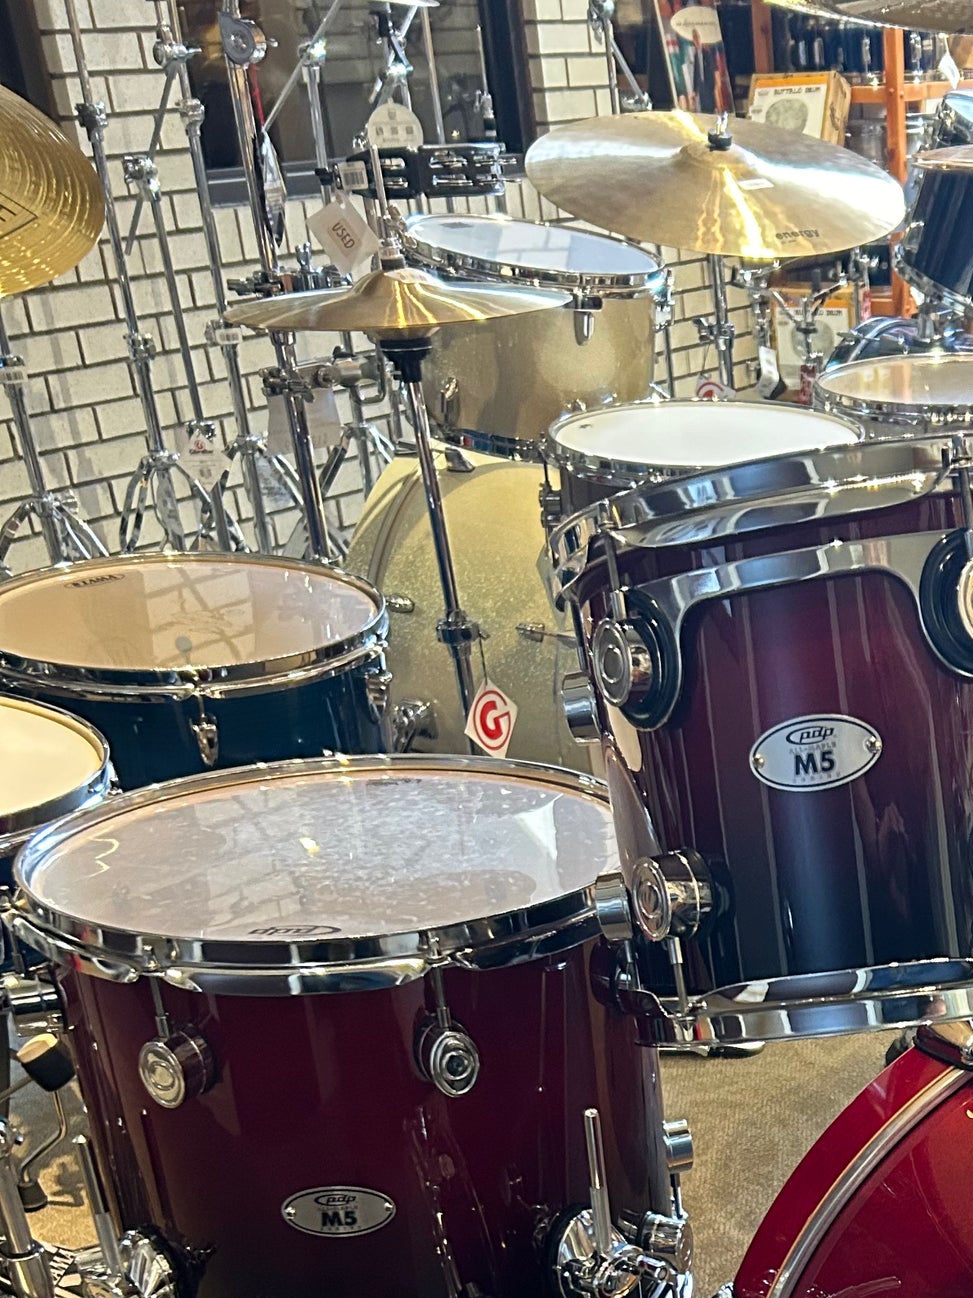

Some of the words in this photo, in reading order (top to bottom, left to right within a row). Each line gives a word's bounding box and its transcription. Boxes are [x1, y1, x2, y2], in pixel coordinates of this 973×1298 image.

[331, 221, 356, 249] USED
[775, 229, 820, 240] energy
[796, 726, 835, 744] pdp
[794, 750, 835, 776] M5
[321, 1211, 358, 1227] M5
